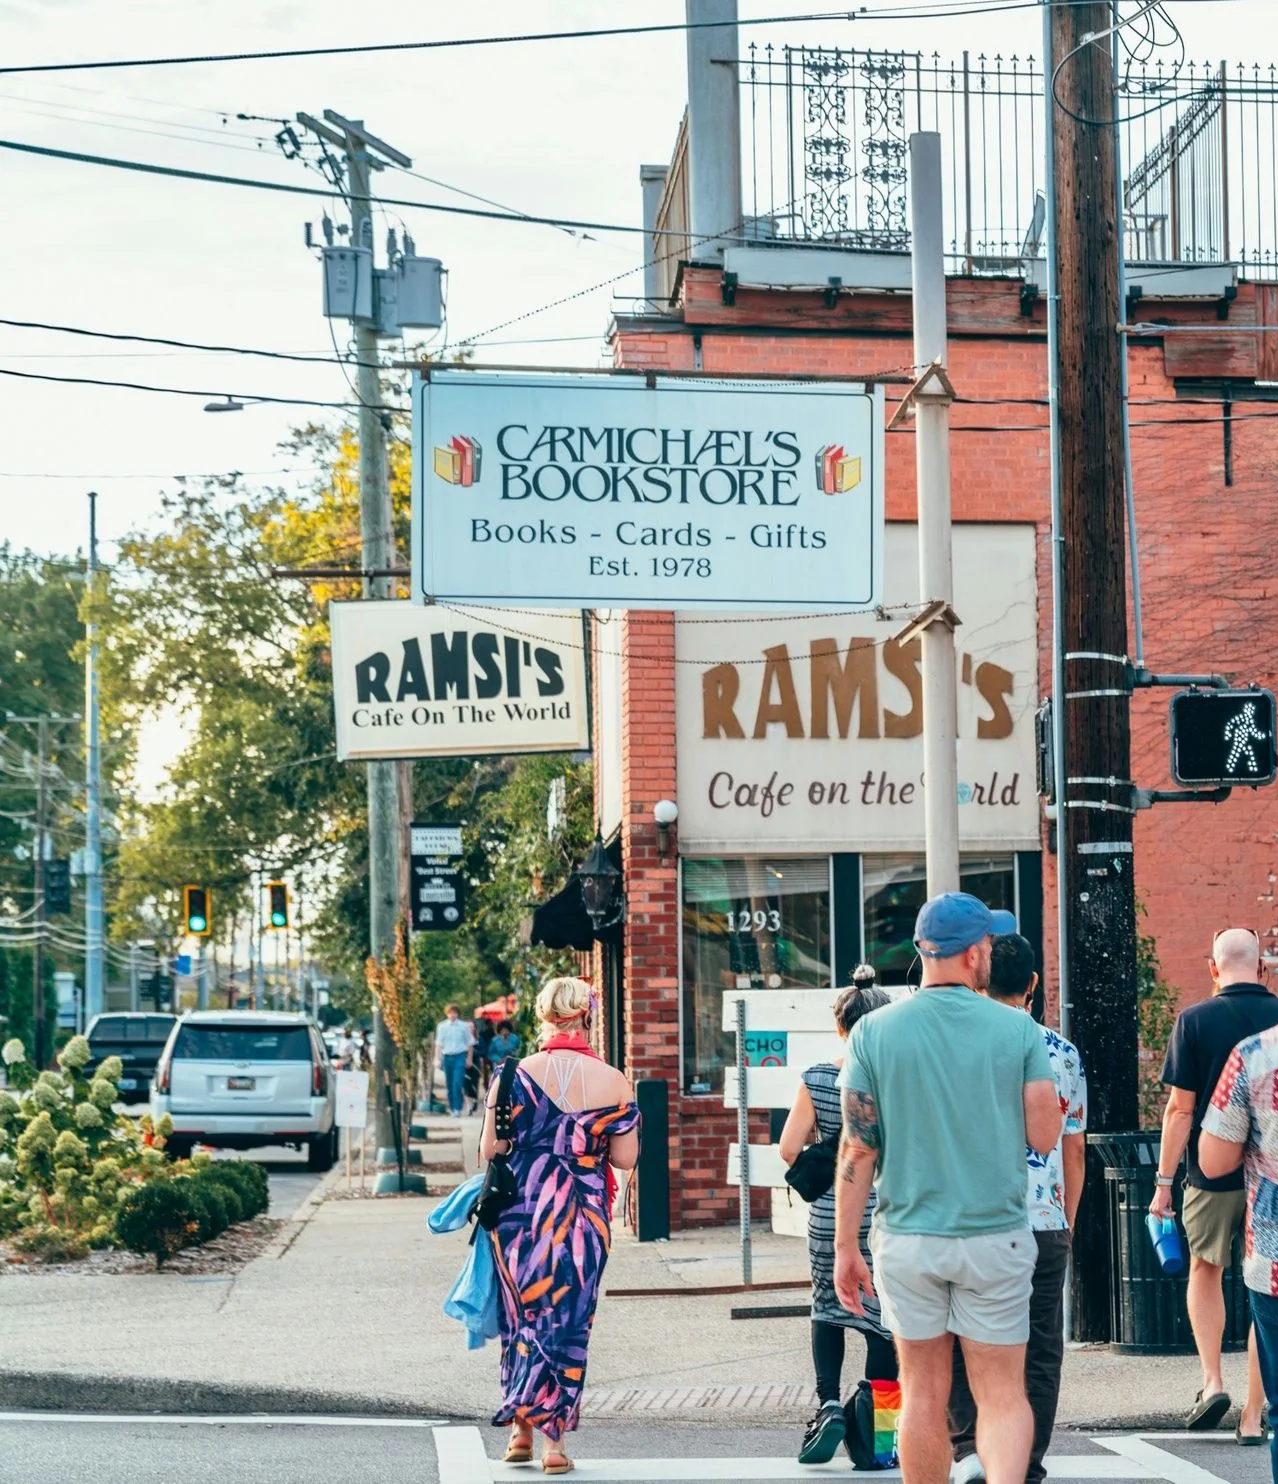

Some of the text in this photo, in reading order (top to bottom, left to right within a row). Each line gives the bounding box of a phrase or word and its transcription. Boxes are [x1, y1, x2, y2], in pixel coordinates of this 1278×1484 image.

[500, 464, 800, 506] BOOKSTORE
[471, 518, 577, 545] Books
[616, 521, 712, 547] Cards
[751, 524, 827, 549] Gifts
[588, 557, 712, 578] Est. 1978
[355, 631, 565, 703] RAMSI'S
[702, 637, 1014, 739] RAMS'S
[352, 702, 571, 728] Cafe On The World
[708, 770, 1020, 817] Cafe on the rld
[726, 910, 781, 932] 1293
